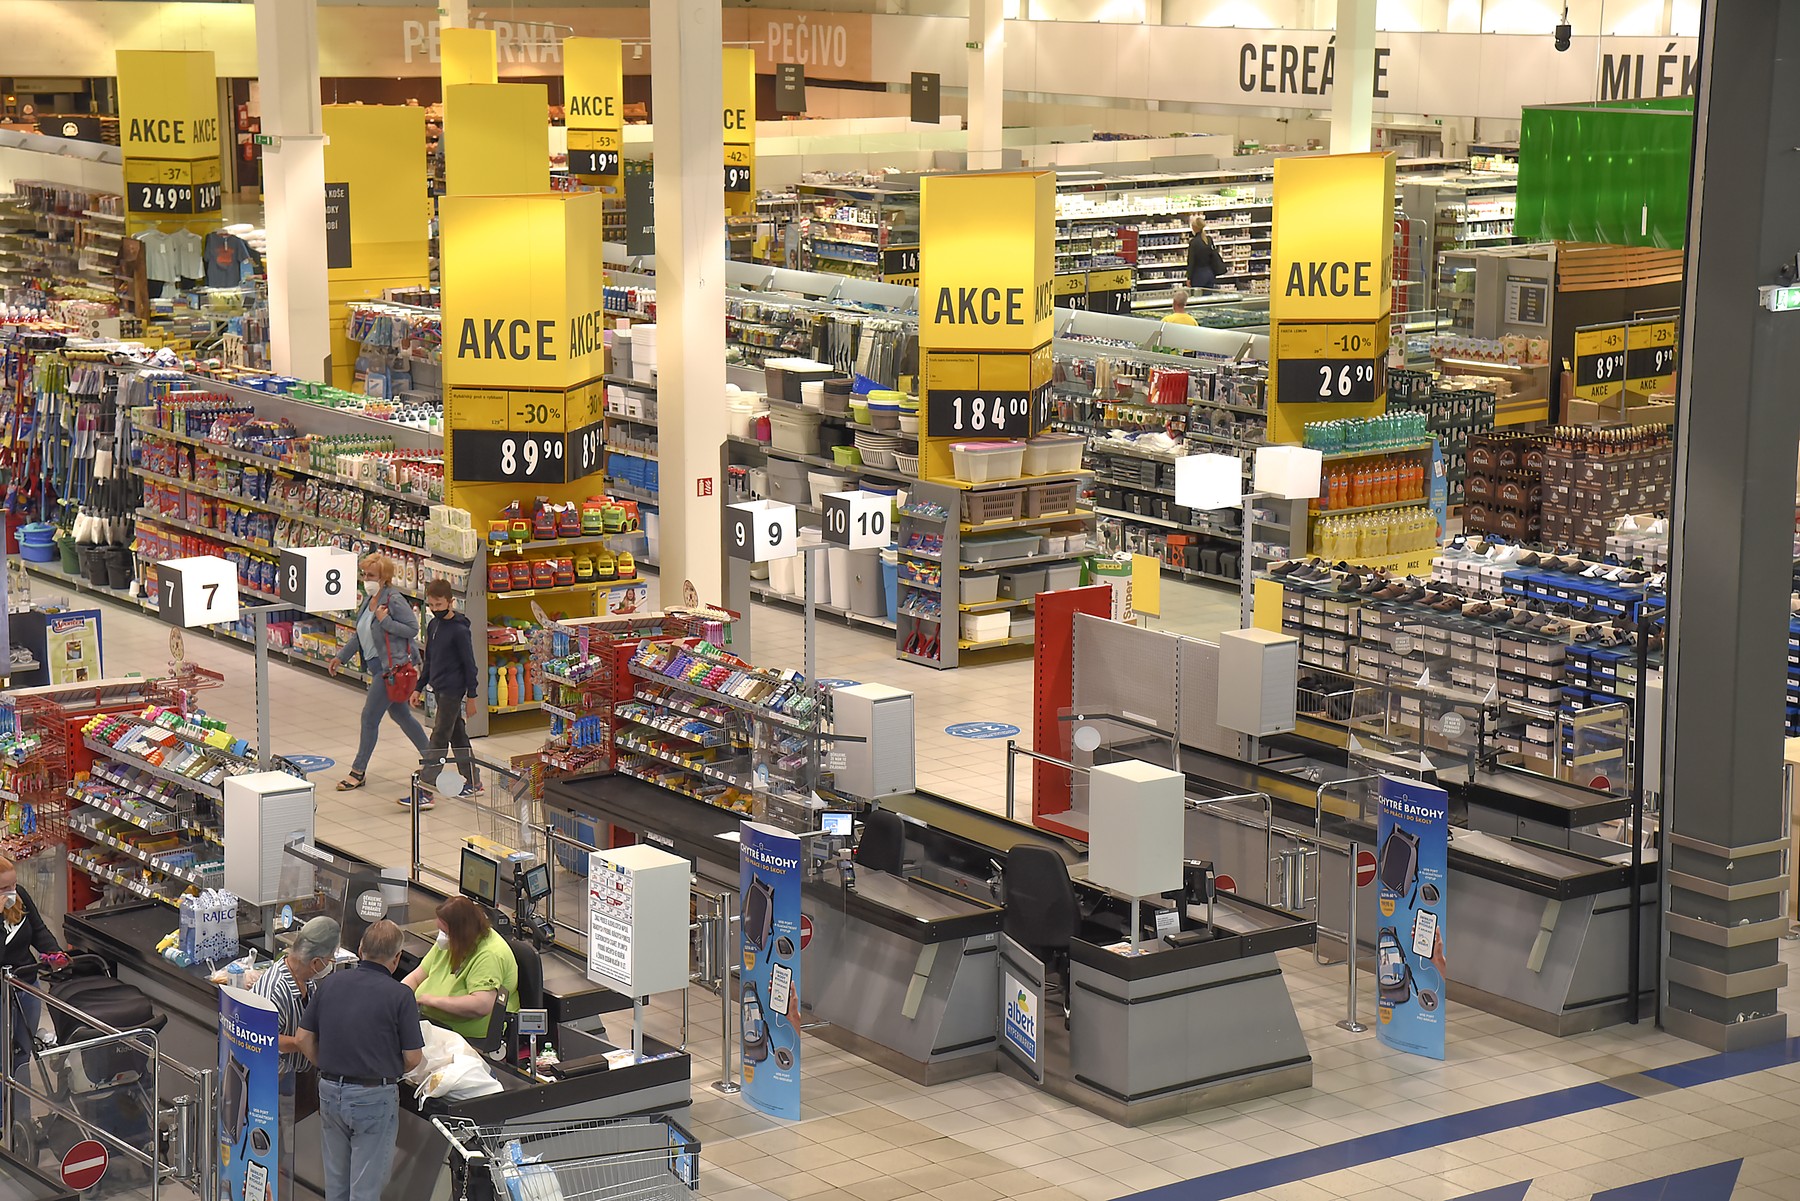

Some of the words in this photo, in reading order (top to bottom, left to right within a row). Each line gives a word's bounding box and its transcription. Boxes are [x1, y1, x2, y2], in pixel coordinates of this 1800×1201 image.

[768, 15, 847, 67] PEČIVO
[1239, 36, 1391, 98] CEREÁE
[570, 96, 615, 117] AKCE
[723, 109, 746, 129] CE
[129, 118, 186, 144] AKCE
[193, 118, 217, 144] AKCE
[1285, 262, 1372, 297] AKCE
[934, 287, 1025, 325] AKCE
[1034, 278, 1053, 324] AKCE
[457, 318, 557, 361] AKCE
[570, 310, 601, 360] AKCE
[1591, 385, 1608, 397] AKCE
[1640, 379, 1657, 391] AKCE
[826, 507, 846, 534] 10
[857, 511, 885, 536] 10
[735, 522, 746, 547] 9
[768, 522, 782, 546] 9
[1407, 561, 1419, 569] AKCE
[288, 565, 298, 593] 8
[324, 569, 341, 595] 8
[165, 581, 175, 608] 7
[202, 584, 219, 610] 7
[1123, 580, 1132, 620] Super
[1378, 795, 1402, 811] CHYTRÉ
[1404, 803, 1444, 819] BATOHY
[760, 852, 798, 869] BATOHY
[203, 908, 235, 923] RAJEC
[1008, 1001, 1035, 1037] albert
[236, 1025, 275, 1046] BATOHY
[1008, 1024, 1034, 1055] HYPERMARKET
